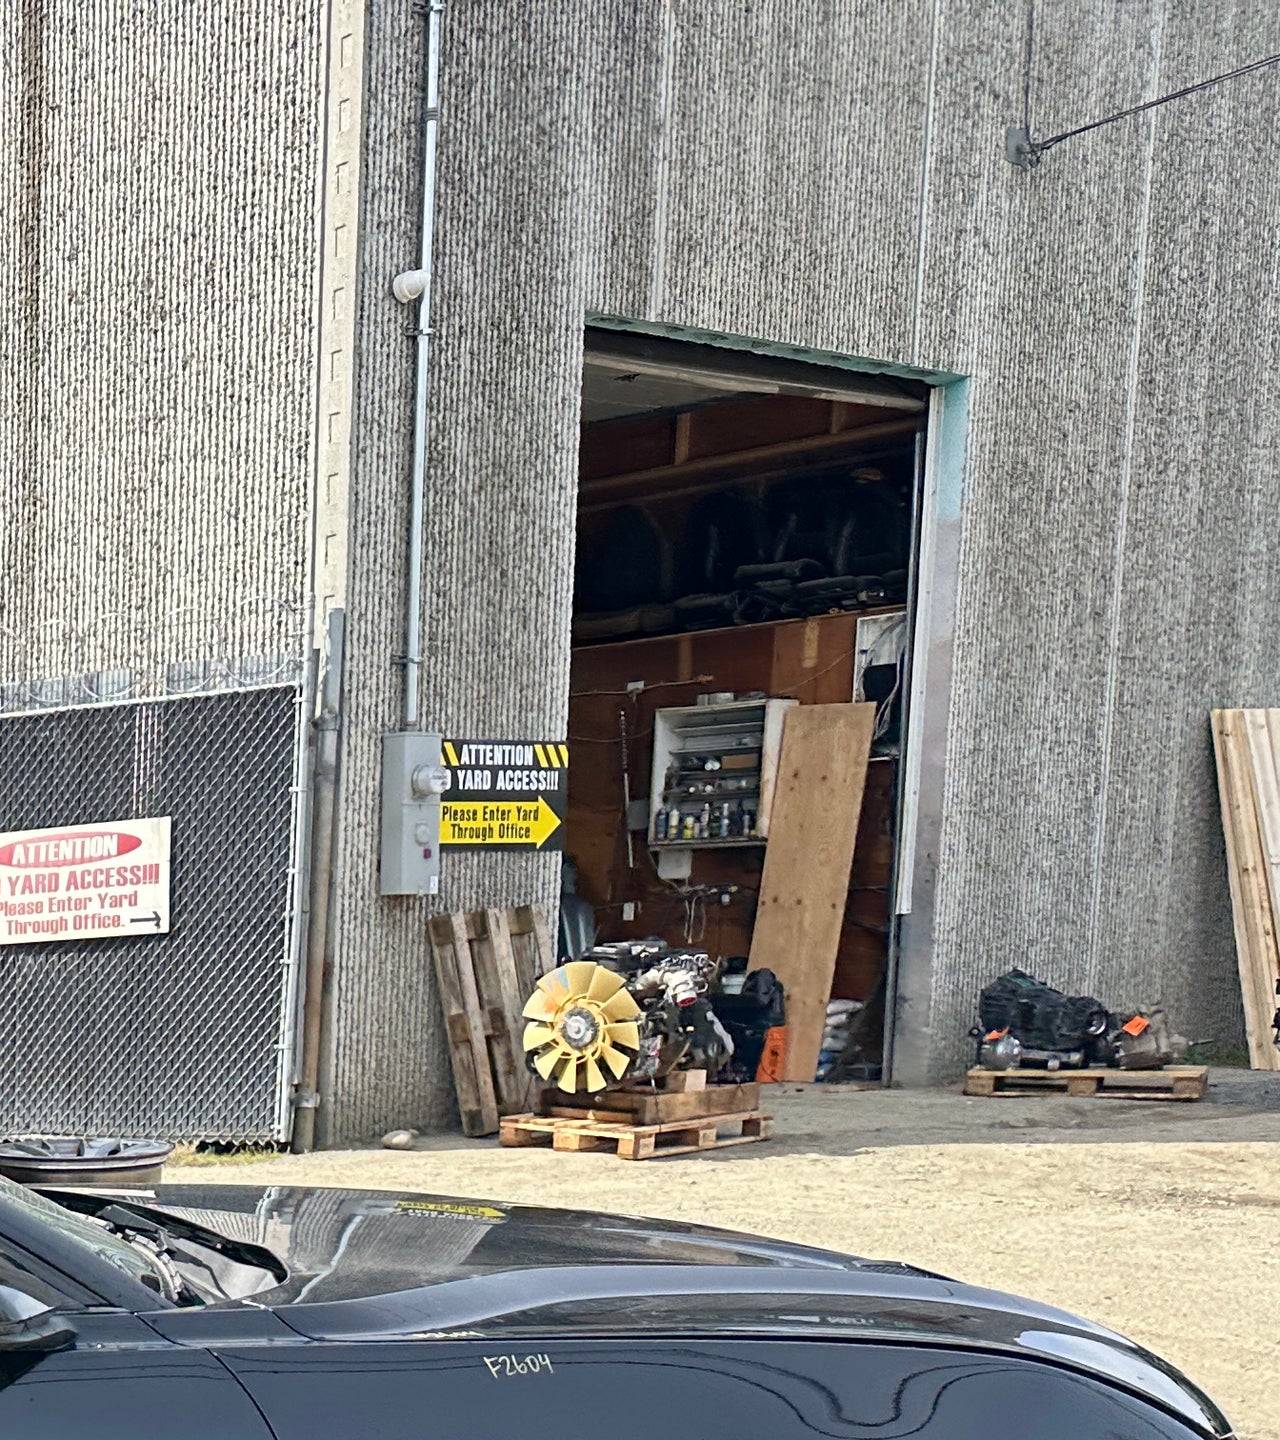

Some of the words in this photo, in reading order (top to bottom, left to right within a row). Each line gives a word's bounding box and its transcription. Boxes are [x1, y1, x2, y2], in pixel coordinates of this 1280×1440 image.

[460, 744, 534, 766] ATTENTION
[456, 769, 492, 790] YARD
[496, 770, 559, 791] ACCESS!!!
[442, 805, 477, 822] Please
[483, 806, 512, 821] Enter
[516, 806, 539, 822] Yard
[451, 823, 494, 841] Through
[499, 824, 531, 839] Office
[11, 834, 119, 865] ATTENTION
[8, 873, 60, 896] YARD
[65, 864, 160, 891] ACCESS!!!
[48, 895, 93, 913] Enter
[98, 891, 138, 908] Yard
[6, 916, 68, 936] Through
[483, 1353, 554, 1379] F2604
